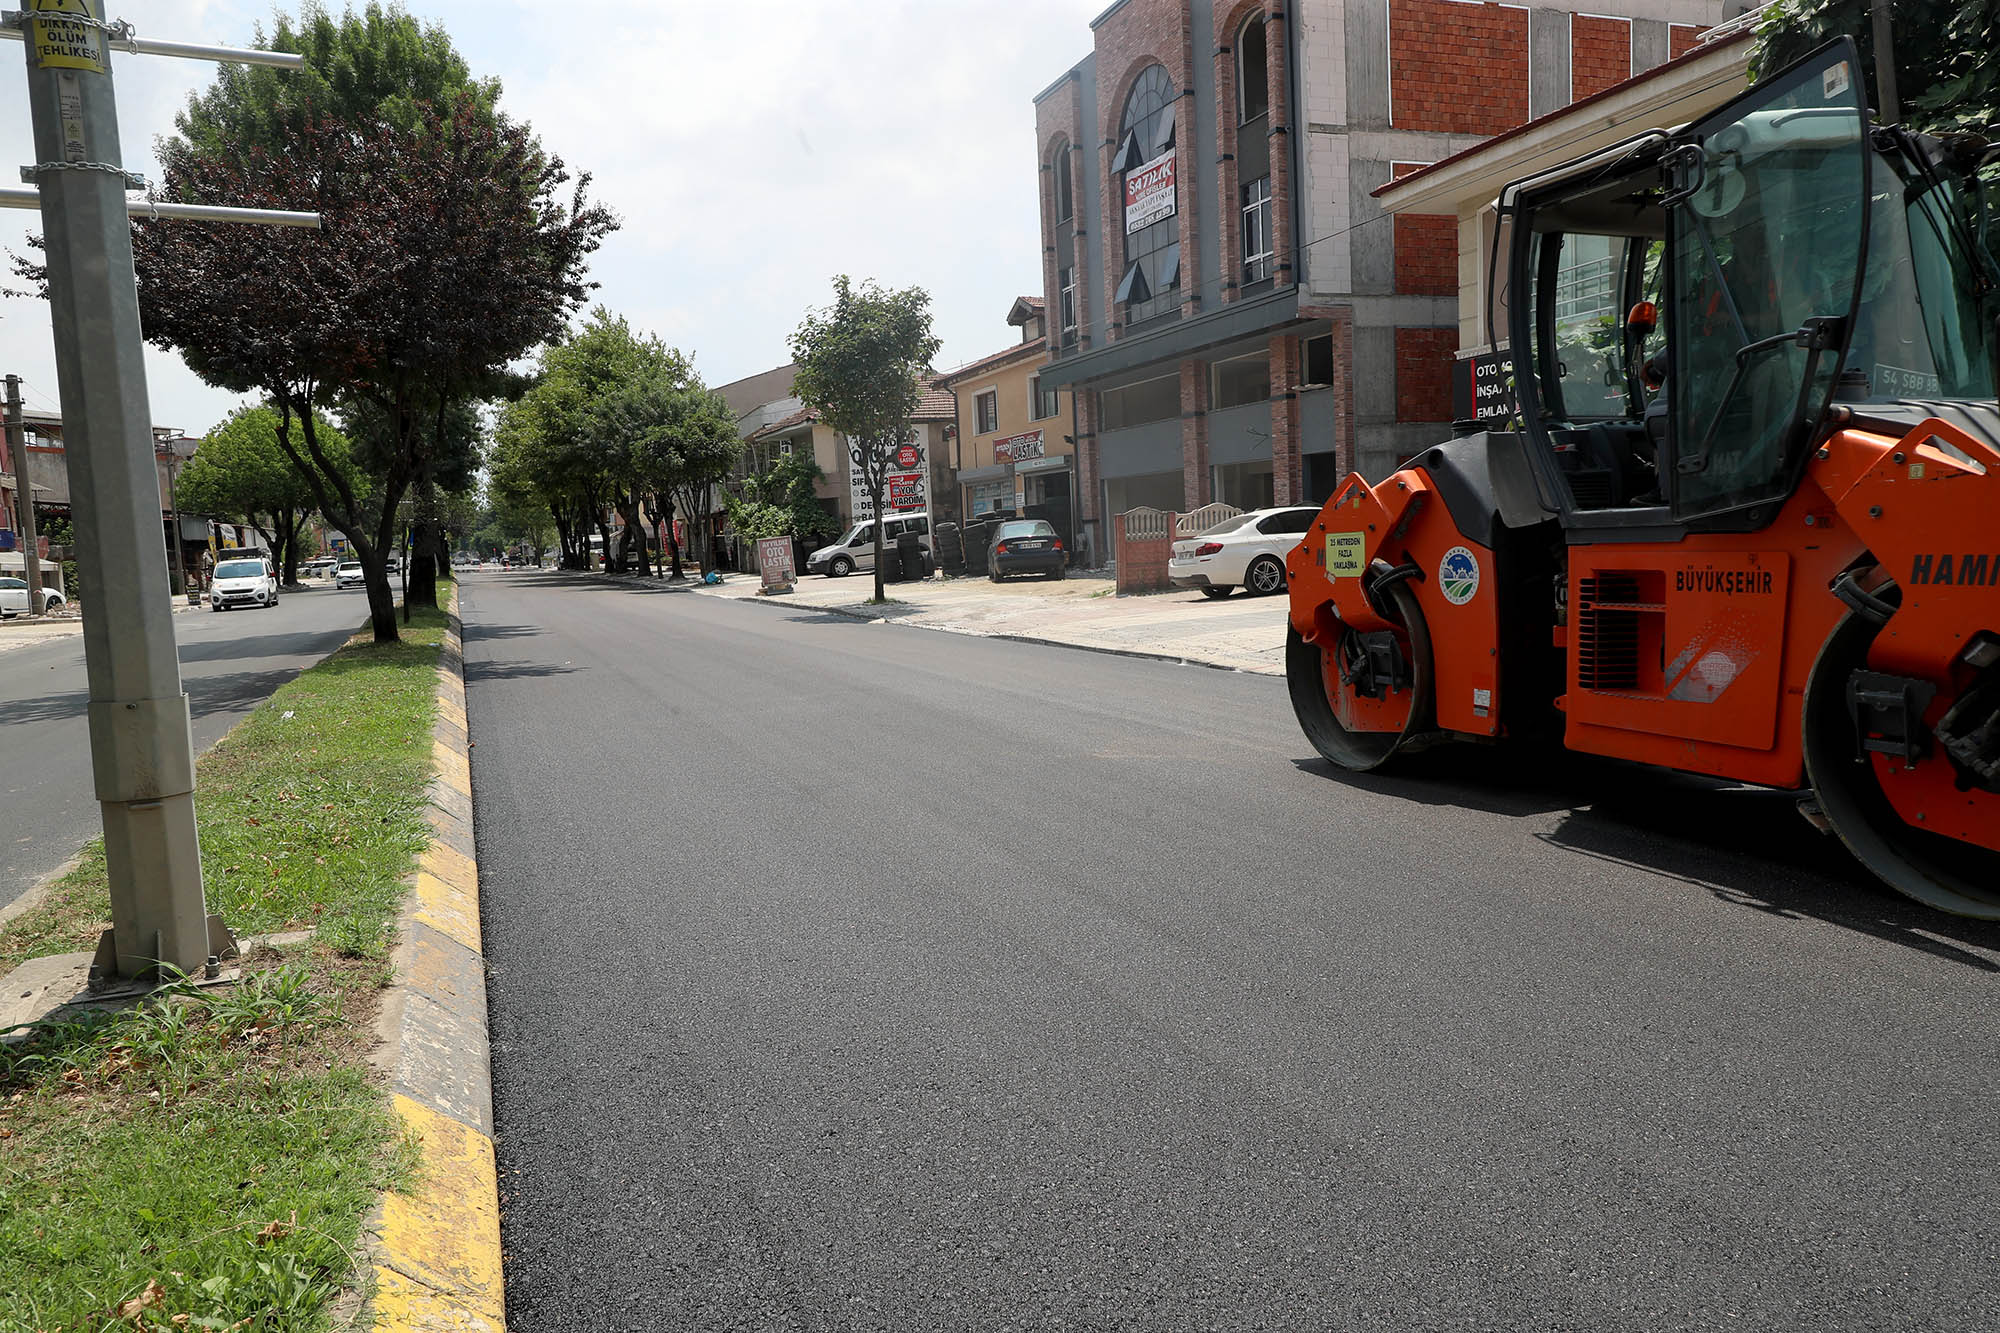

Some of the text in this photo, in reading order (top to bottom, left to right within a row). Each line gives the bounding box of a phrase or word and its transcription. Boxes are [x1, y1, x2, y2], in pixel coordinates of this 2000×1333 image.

[47, 29, 88, 45] ÖLÜM
[38, 45, 101, 61] TEHLİKESİ
[1883, 370, 1897, 385] 54
[1477, 403, 1510, 418] EMLAK
[900, 485, 916, 495] YOL
[1337, 537, 1361, 546] METREDEN
[767, 547, 785, 557] OTO
[1338, 549, 1353, 558] FAZLA
[763, 556, 791, 568] LASTİK
[1676, 564, 1773, 597] BÜYÜKŞEHİR
